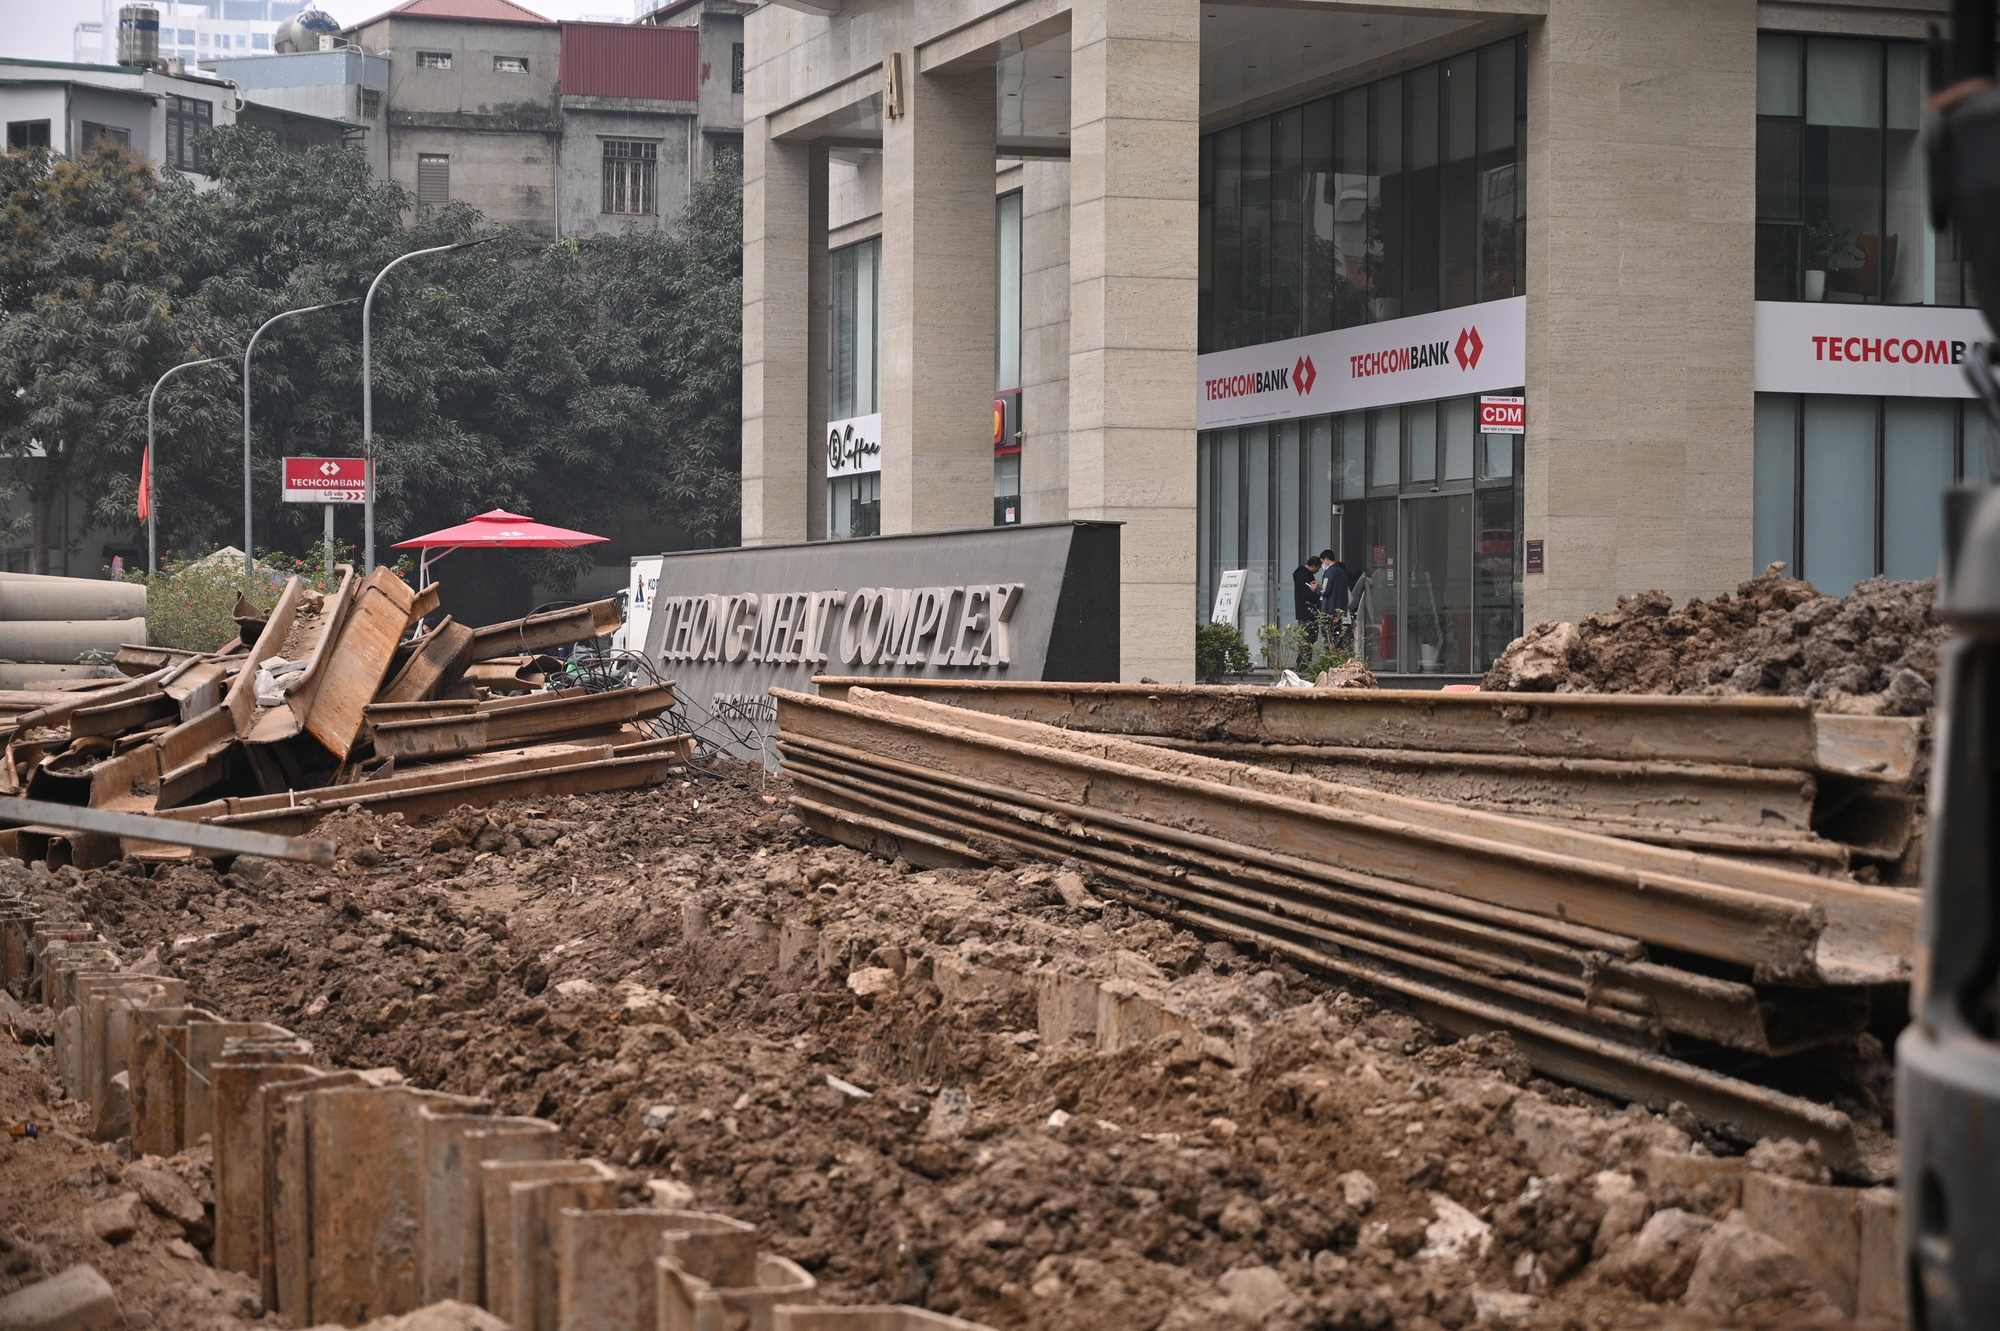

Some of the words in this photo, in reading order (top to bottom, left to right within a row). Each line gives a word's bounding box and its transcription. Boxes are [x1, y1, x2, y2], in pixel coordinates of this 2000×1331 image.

[1349, 341, 1450, 378] TECHCOMBANK
[1812, 336, 2000, 366] TECHCOMB
[1205, 367, 1289, 401] TECHCOMBANK
[1483, 407, 1521, 422] CDM
[840, 583, 1025, 669] COMPLEX
[759, 694, 778, 722] TUA
